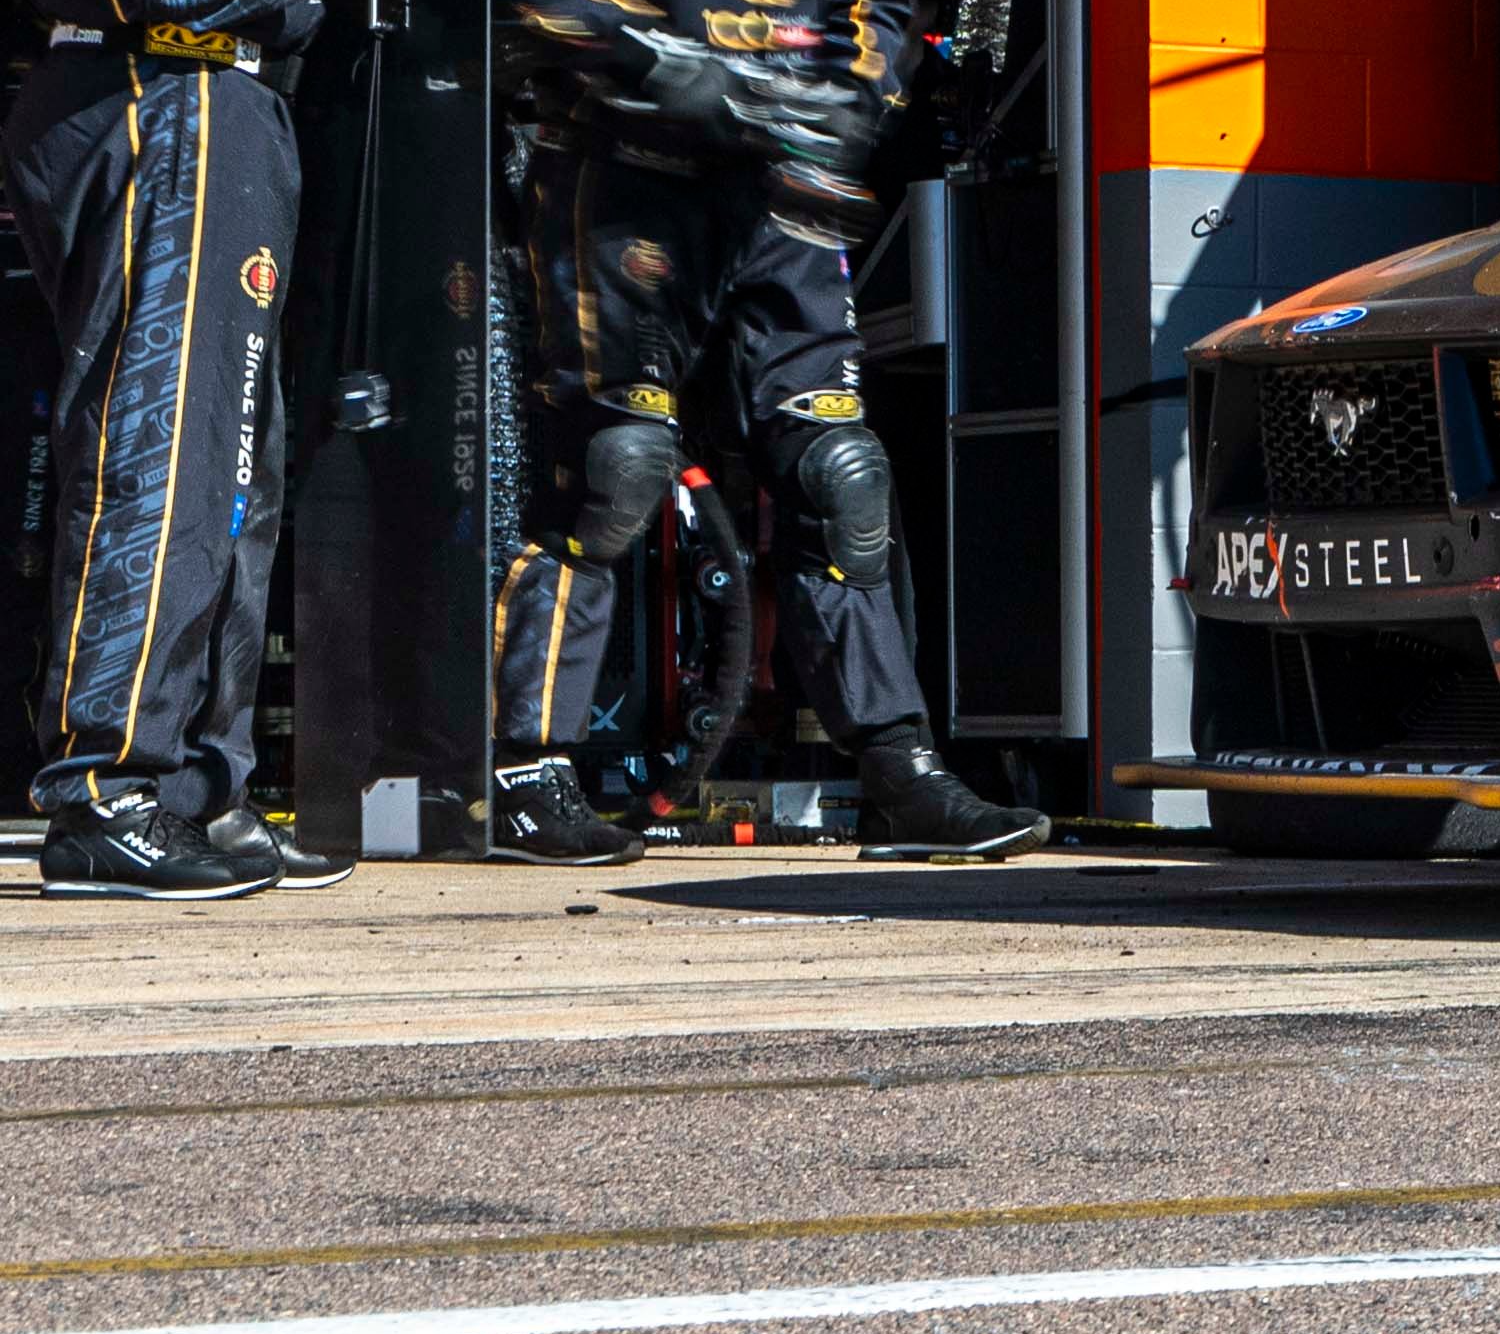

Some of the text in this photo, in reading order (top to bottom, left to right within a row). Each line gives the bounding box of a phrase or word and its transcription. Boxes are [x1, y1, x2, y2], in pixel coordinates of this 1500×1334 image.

[256, 246, 273, 309] PENRITE
[23, 472, 47, 533] SINCE
[1211, 530, 1422, 600] APEX STEEL
